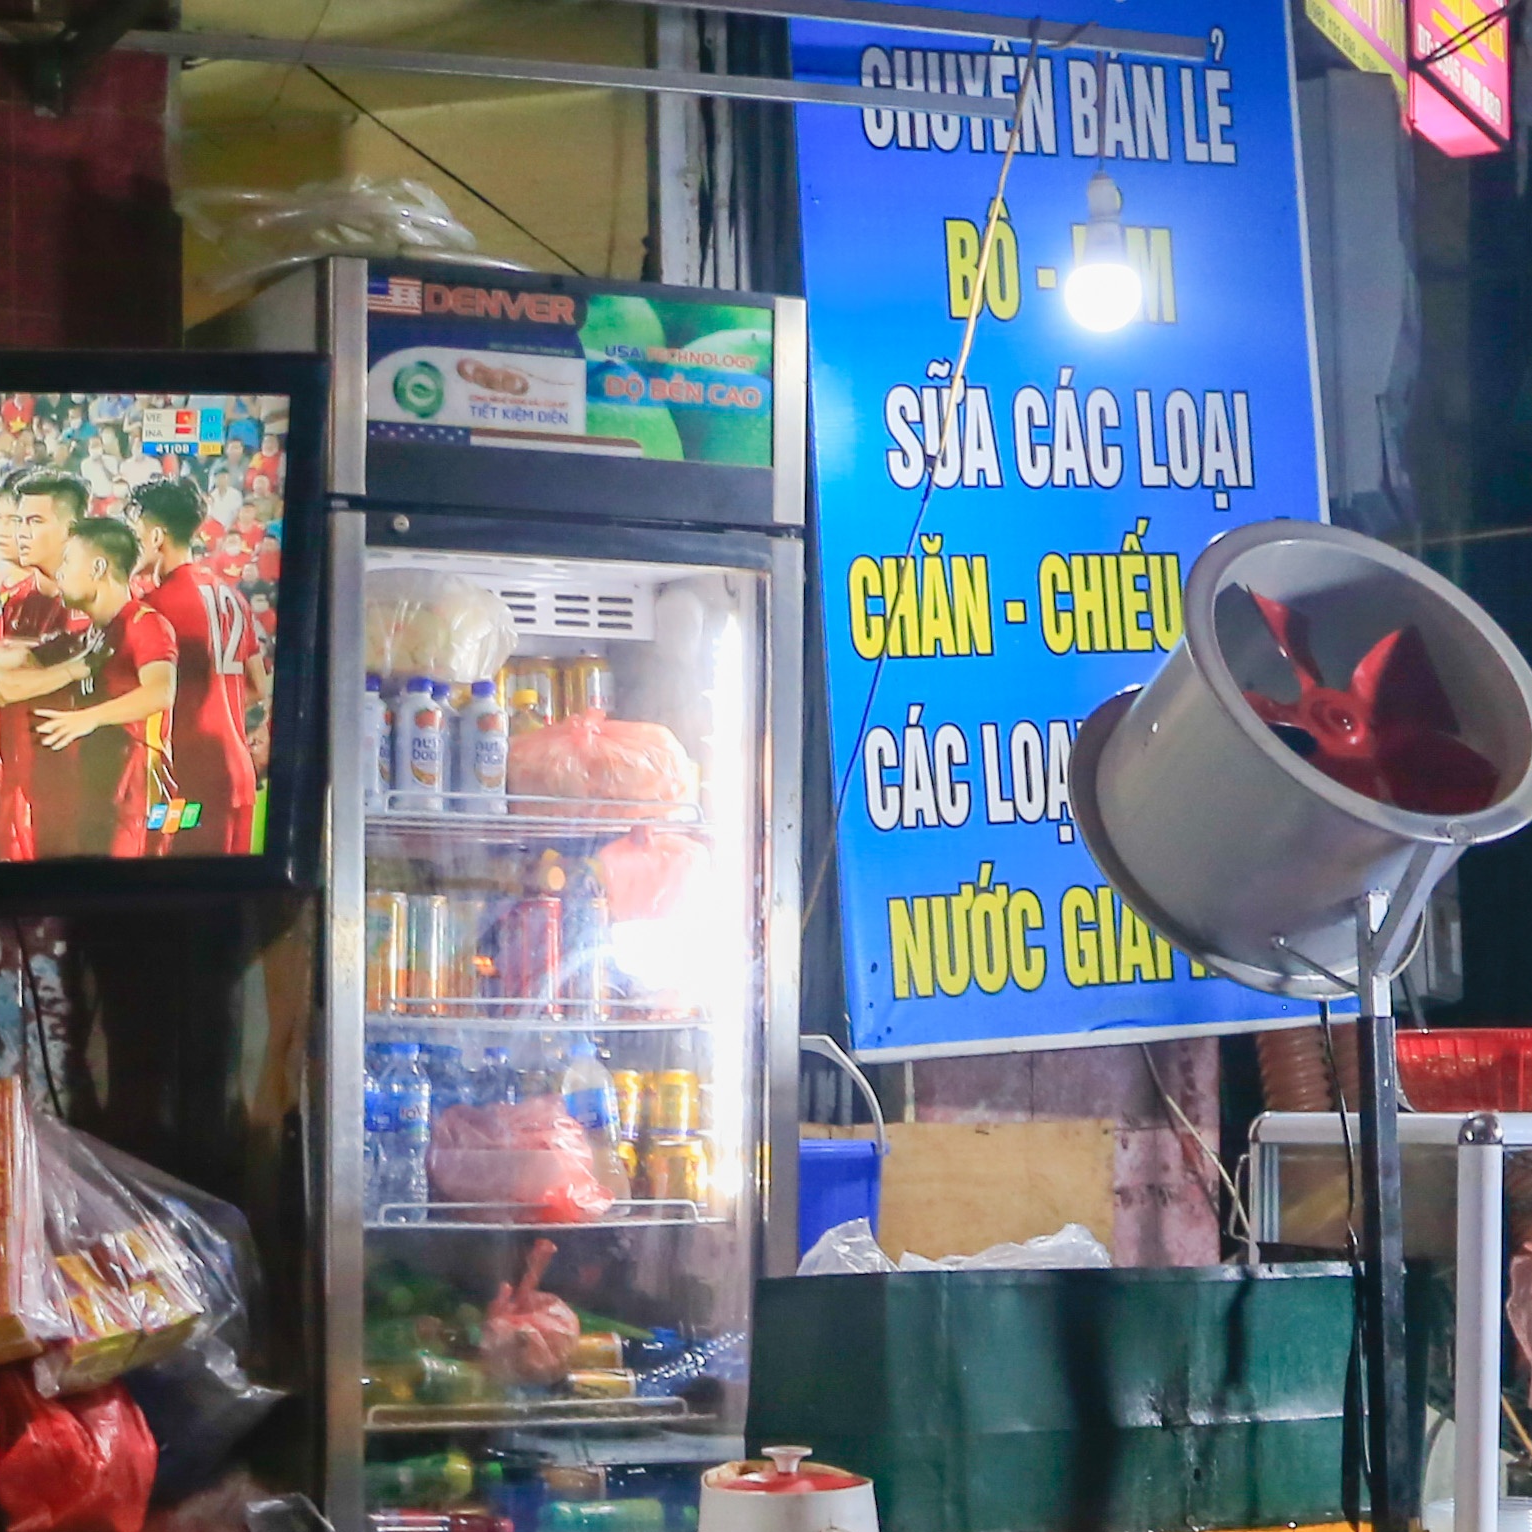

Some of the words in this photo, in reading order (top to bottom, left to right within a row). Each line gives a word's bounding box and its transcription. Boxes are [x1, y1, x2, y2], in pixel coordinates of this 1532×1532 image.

[860, 40, 1059, 156] CHUYÊN
[1181, 27, 1238, 165] LẺ
[424, 283, 576, 326] DENVER
[604, 344, 642, 360] USA
[647, 346, 758, 370] TECHNOLOGY
[145, 413, 163, 423] VIE
[708, 383, 762, 409] CAO
[145, 428, 164, 438] INA
[885, 358, 1003, 490] SỮA
[1012, 366, 1125, 490] CÁC
[1133, 388, 1256, 511] LOẠI
[847, 533, 993, 660] CHĂN
[1037, 518, 1184, 655] CHIẾU
[198, 583, 245, 676] 12
[862, 703, 971, 832] CÁC
[979, 720, 1079, 844] LOẠ
[147, 798, 203, 835] FPT
[887, 861, 1047, 1001] NƯỚC
